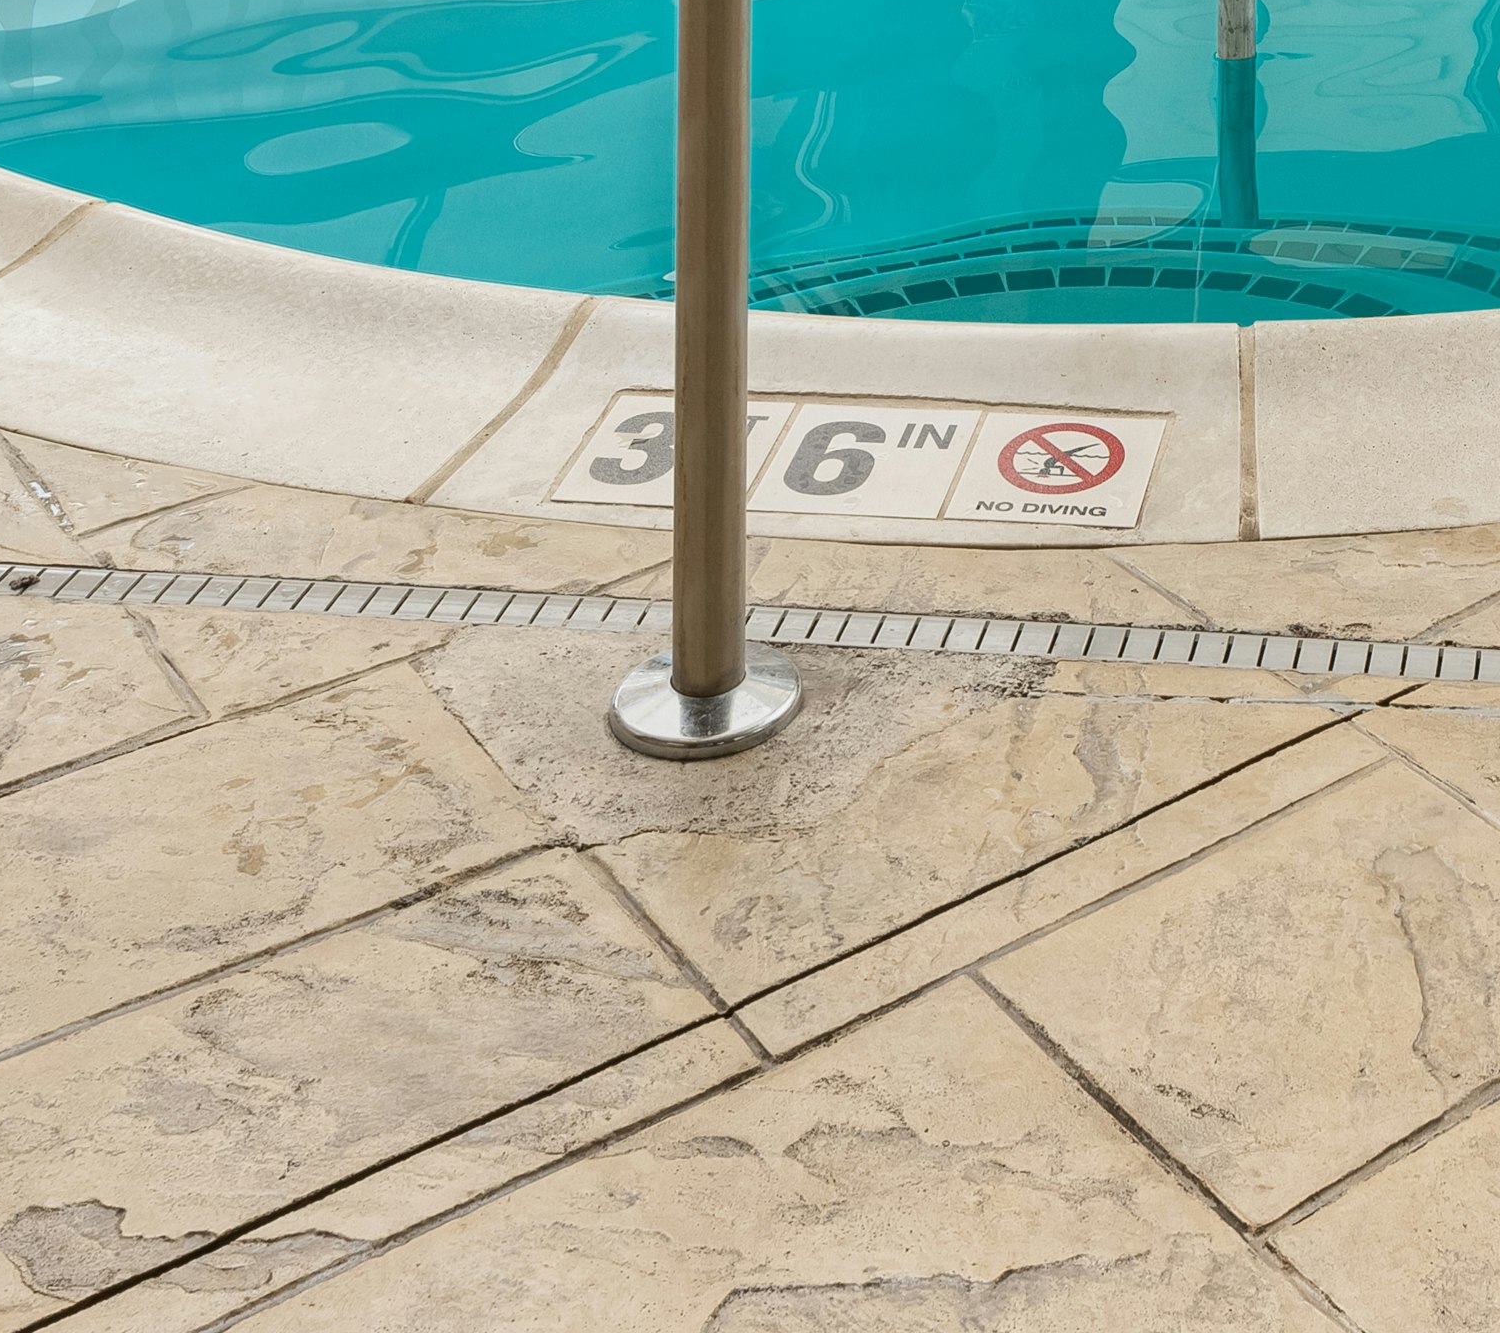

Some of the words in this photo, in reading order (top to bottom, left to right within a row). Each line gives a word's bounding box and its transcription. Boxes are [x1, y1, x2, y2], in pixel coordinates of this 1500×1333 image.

[588, 411, 675, 486] 3
[783, 420, 887, 496] 6
[897, 422, 959, 450] IN
[975, 500, 1014, 513] NO
[1020, 502, 1108, 517] DIVING
